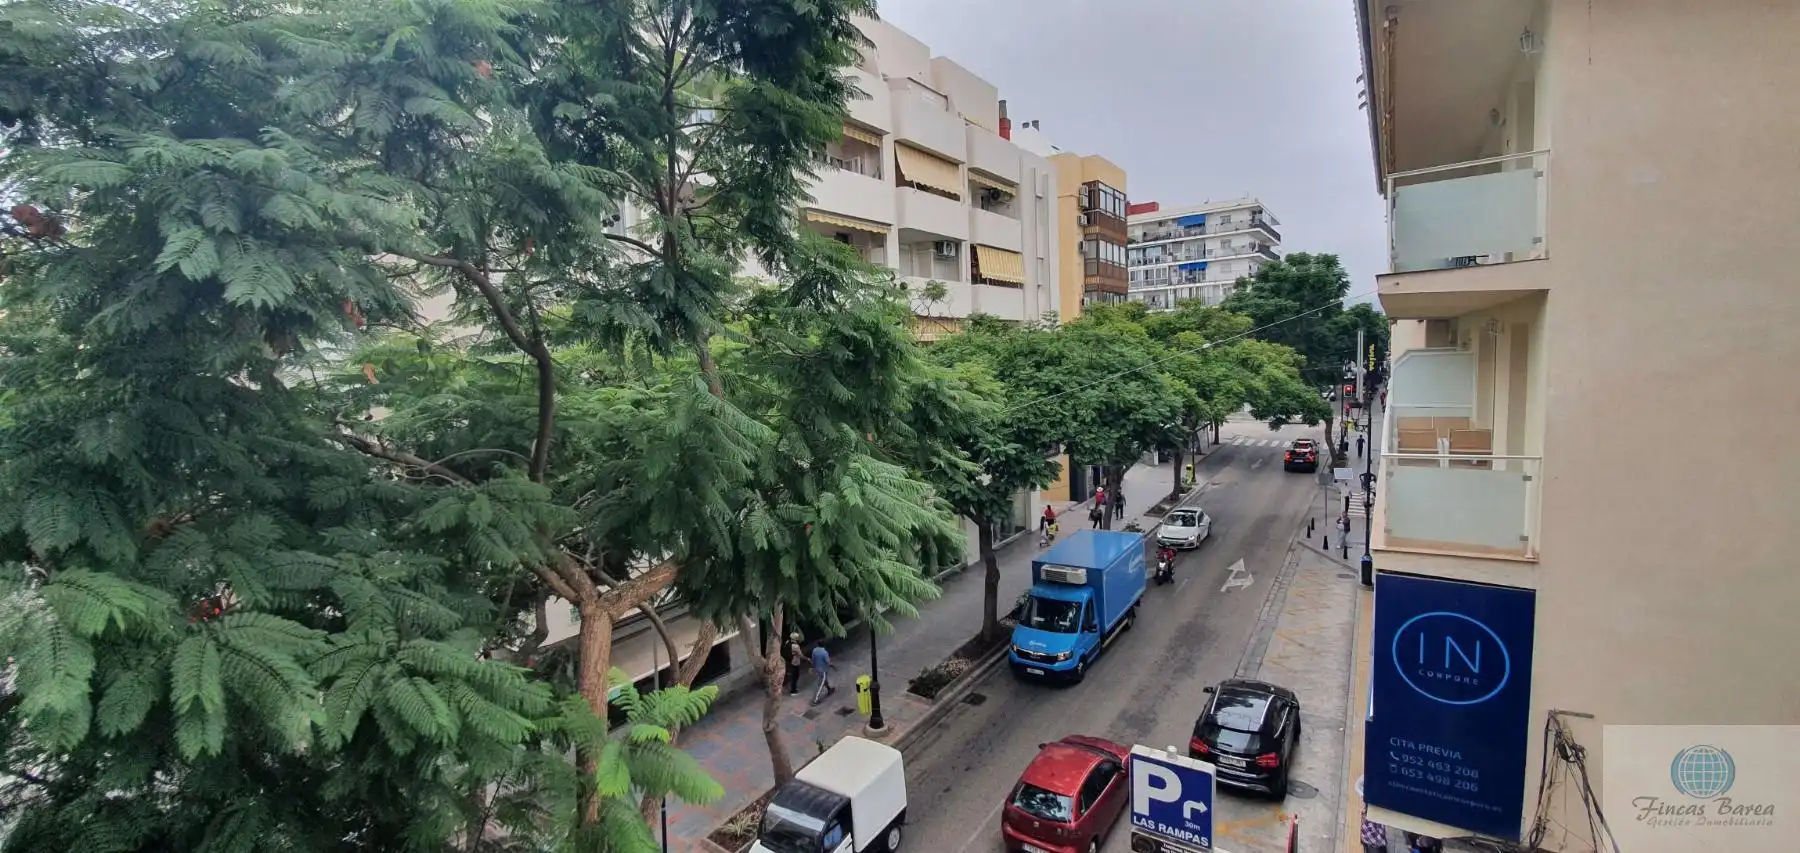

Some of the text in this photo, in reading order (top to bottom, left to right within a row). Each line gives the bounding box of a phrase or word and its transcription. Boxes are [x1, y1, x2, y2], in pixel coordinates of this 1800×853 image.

[1419, 632, 1481, 674] IN
[1418, 668, 1480, 685] CORPORE
[1390, 737, 1463, 760] CITA PREVIA
[1402, 754, 1424, 766] 952
[1401, 767, 1424, 779] 653
[1133, 758, 1182, 816] P
[1133, 816, 1208, 847] LAS RAMPAS
[1185, 821, 1200, 831] 30m
